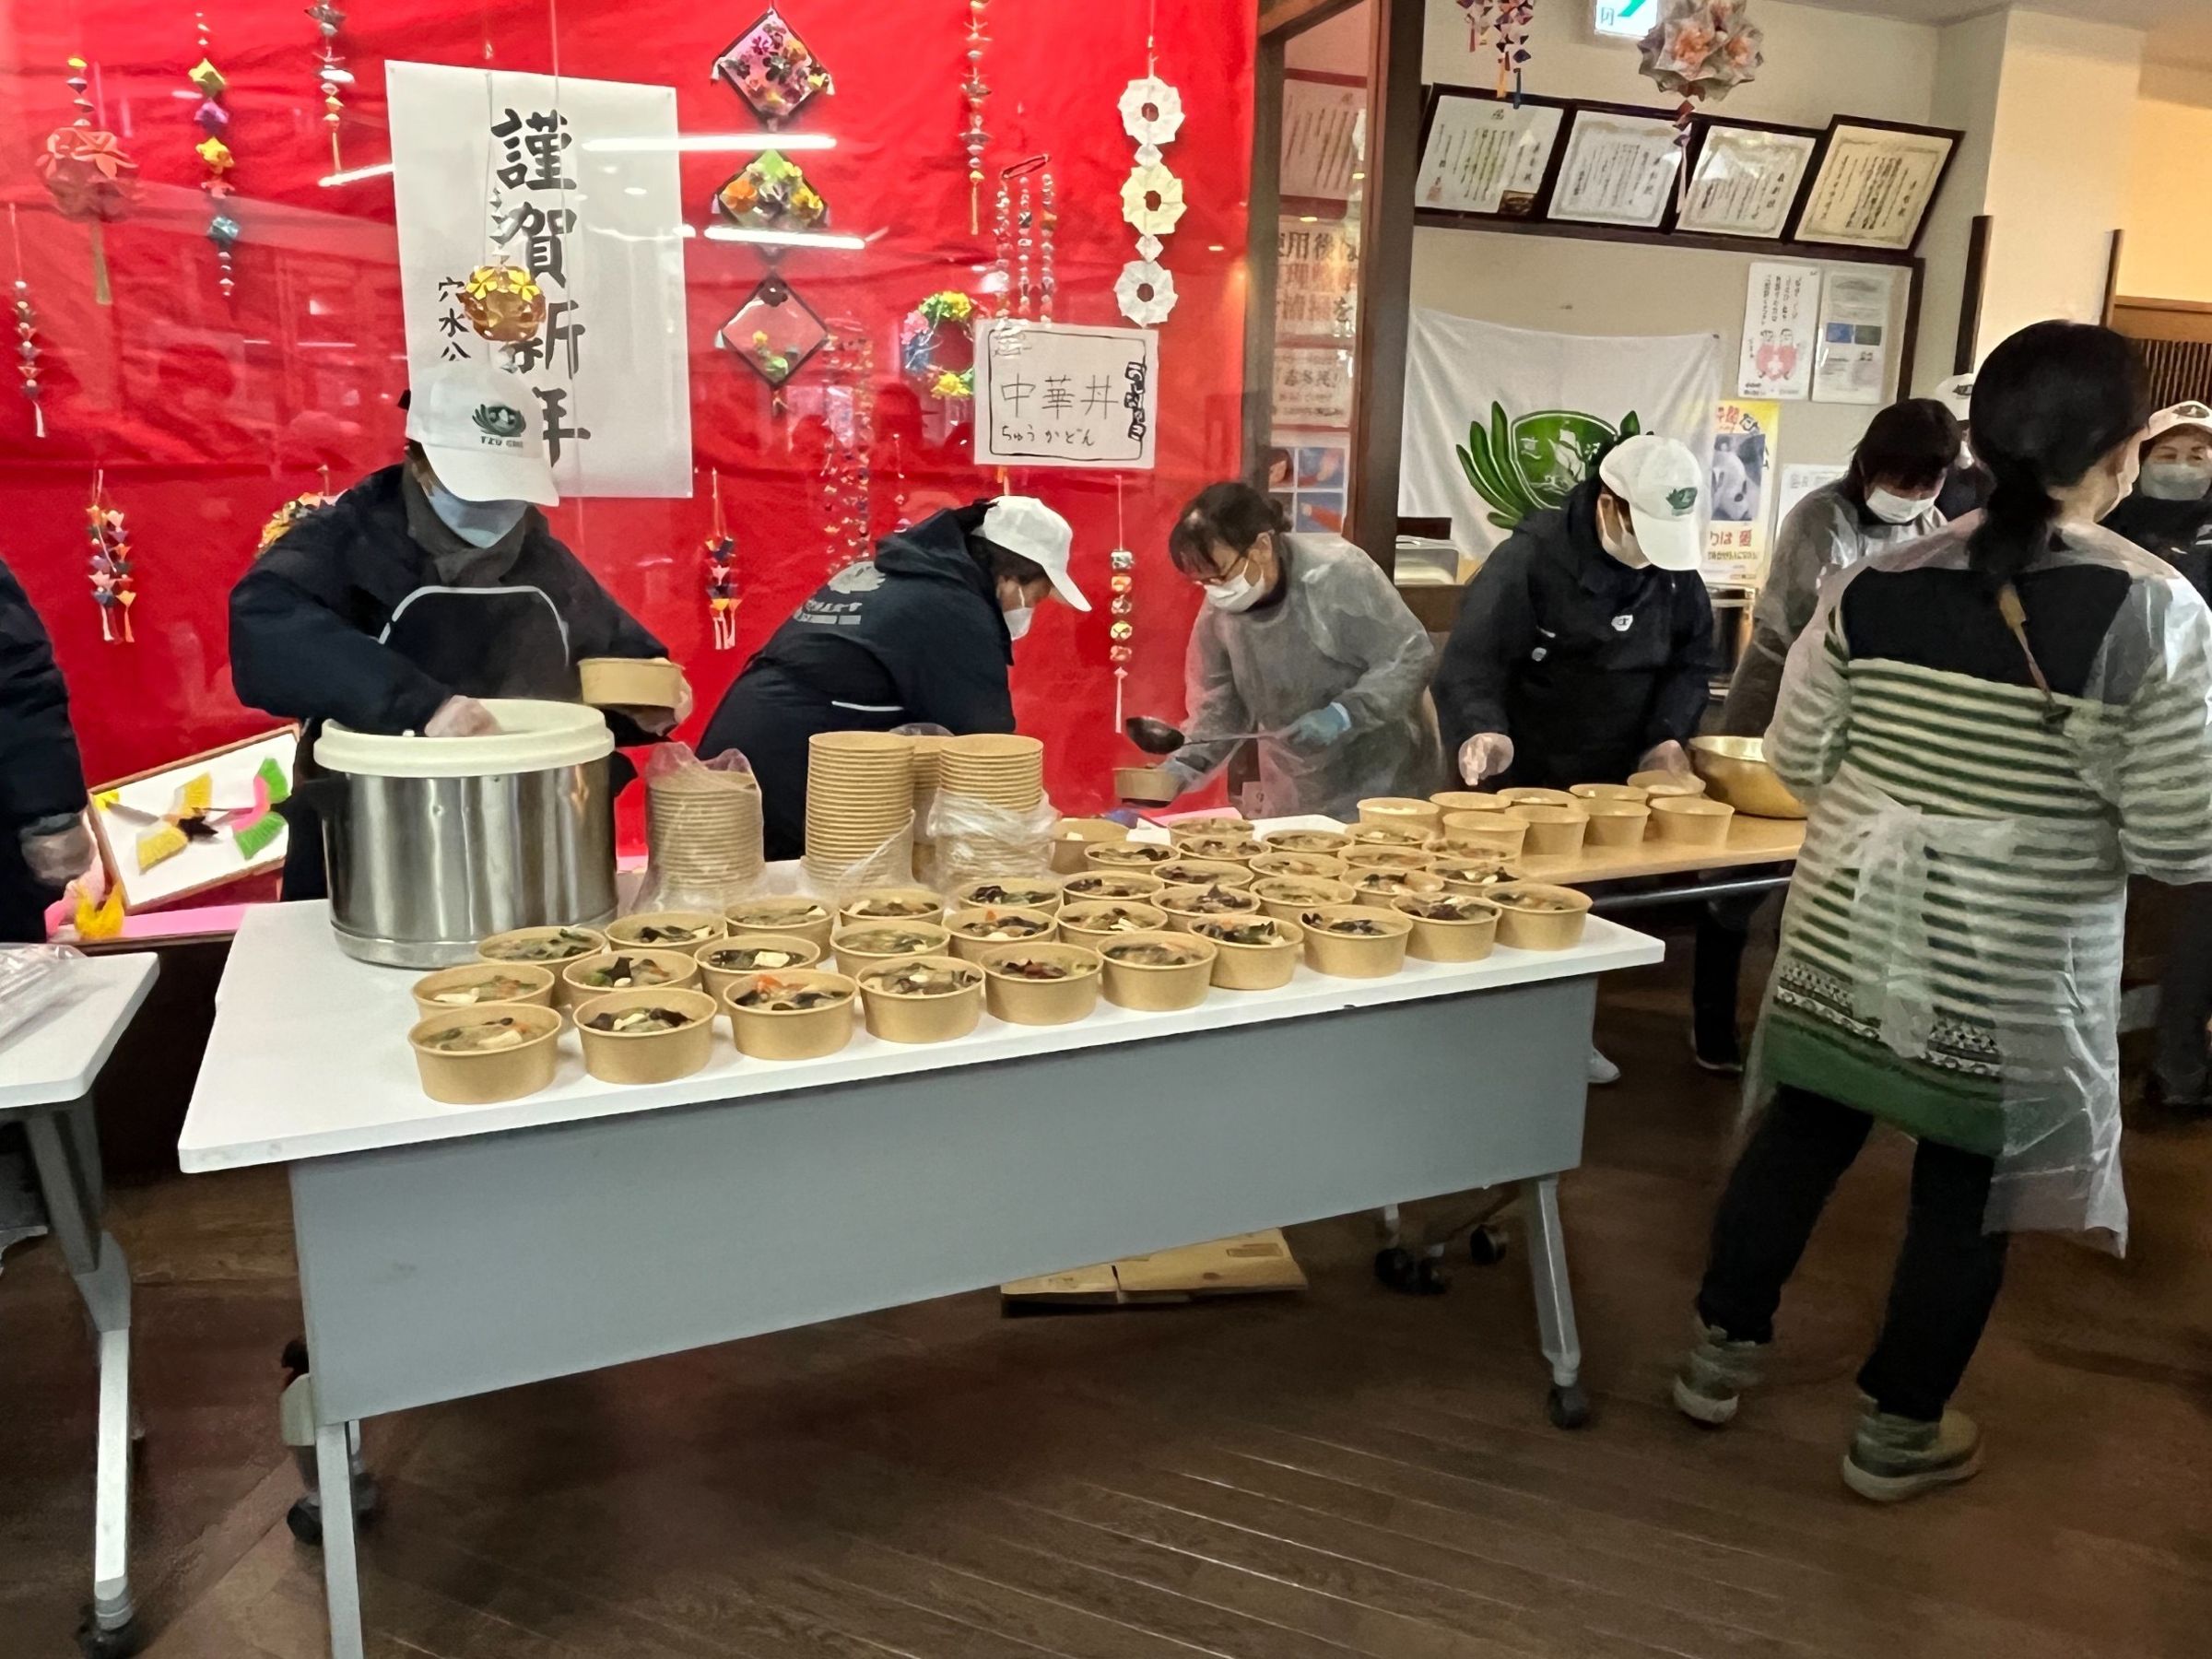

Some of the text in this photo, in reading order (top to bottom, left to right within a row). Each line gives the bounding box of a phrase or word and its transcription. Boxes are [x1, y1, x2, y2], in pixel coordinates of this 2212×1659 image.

[1001, 372, 1119, 420] 中華丼
[1001, 424, 1096, 447] ちゅうかどん
